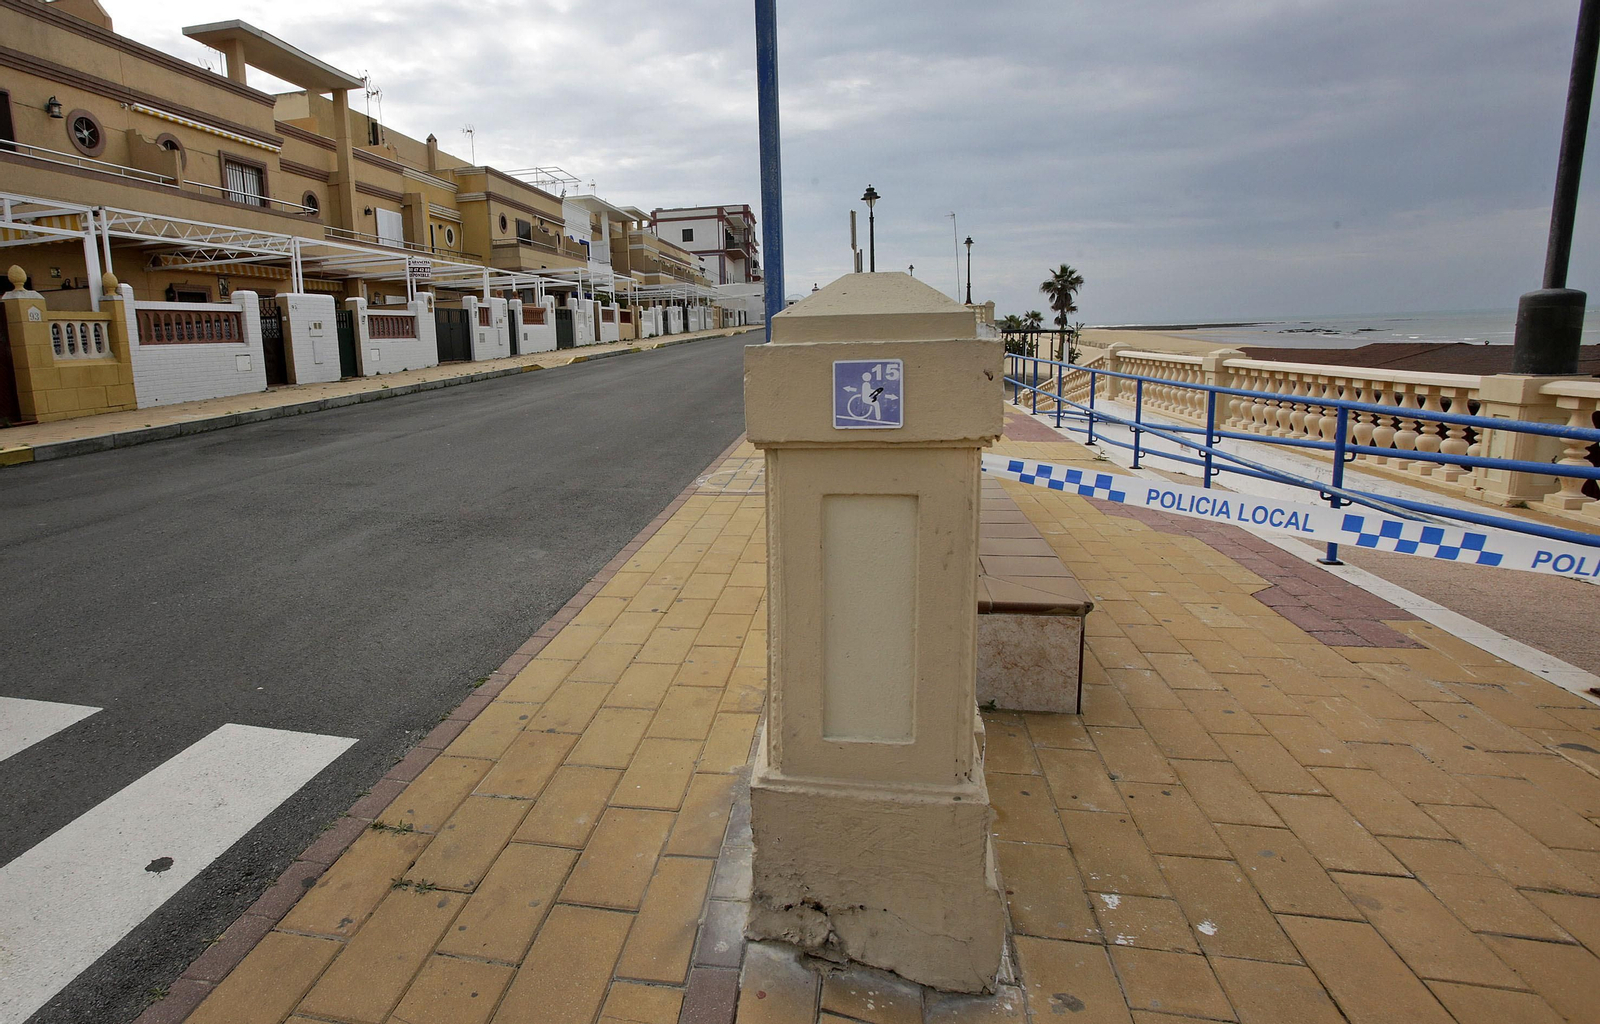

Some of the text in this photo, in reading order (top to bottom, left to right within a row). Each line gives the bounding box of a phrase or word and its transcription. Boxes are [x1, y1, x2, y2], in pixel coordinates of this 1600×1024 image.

[29, 312, 40, 320] 93
[871, 364, 900, 381] 15
[1145, 488, 1315, 533] POLICIA LOCAL
